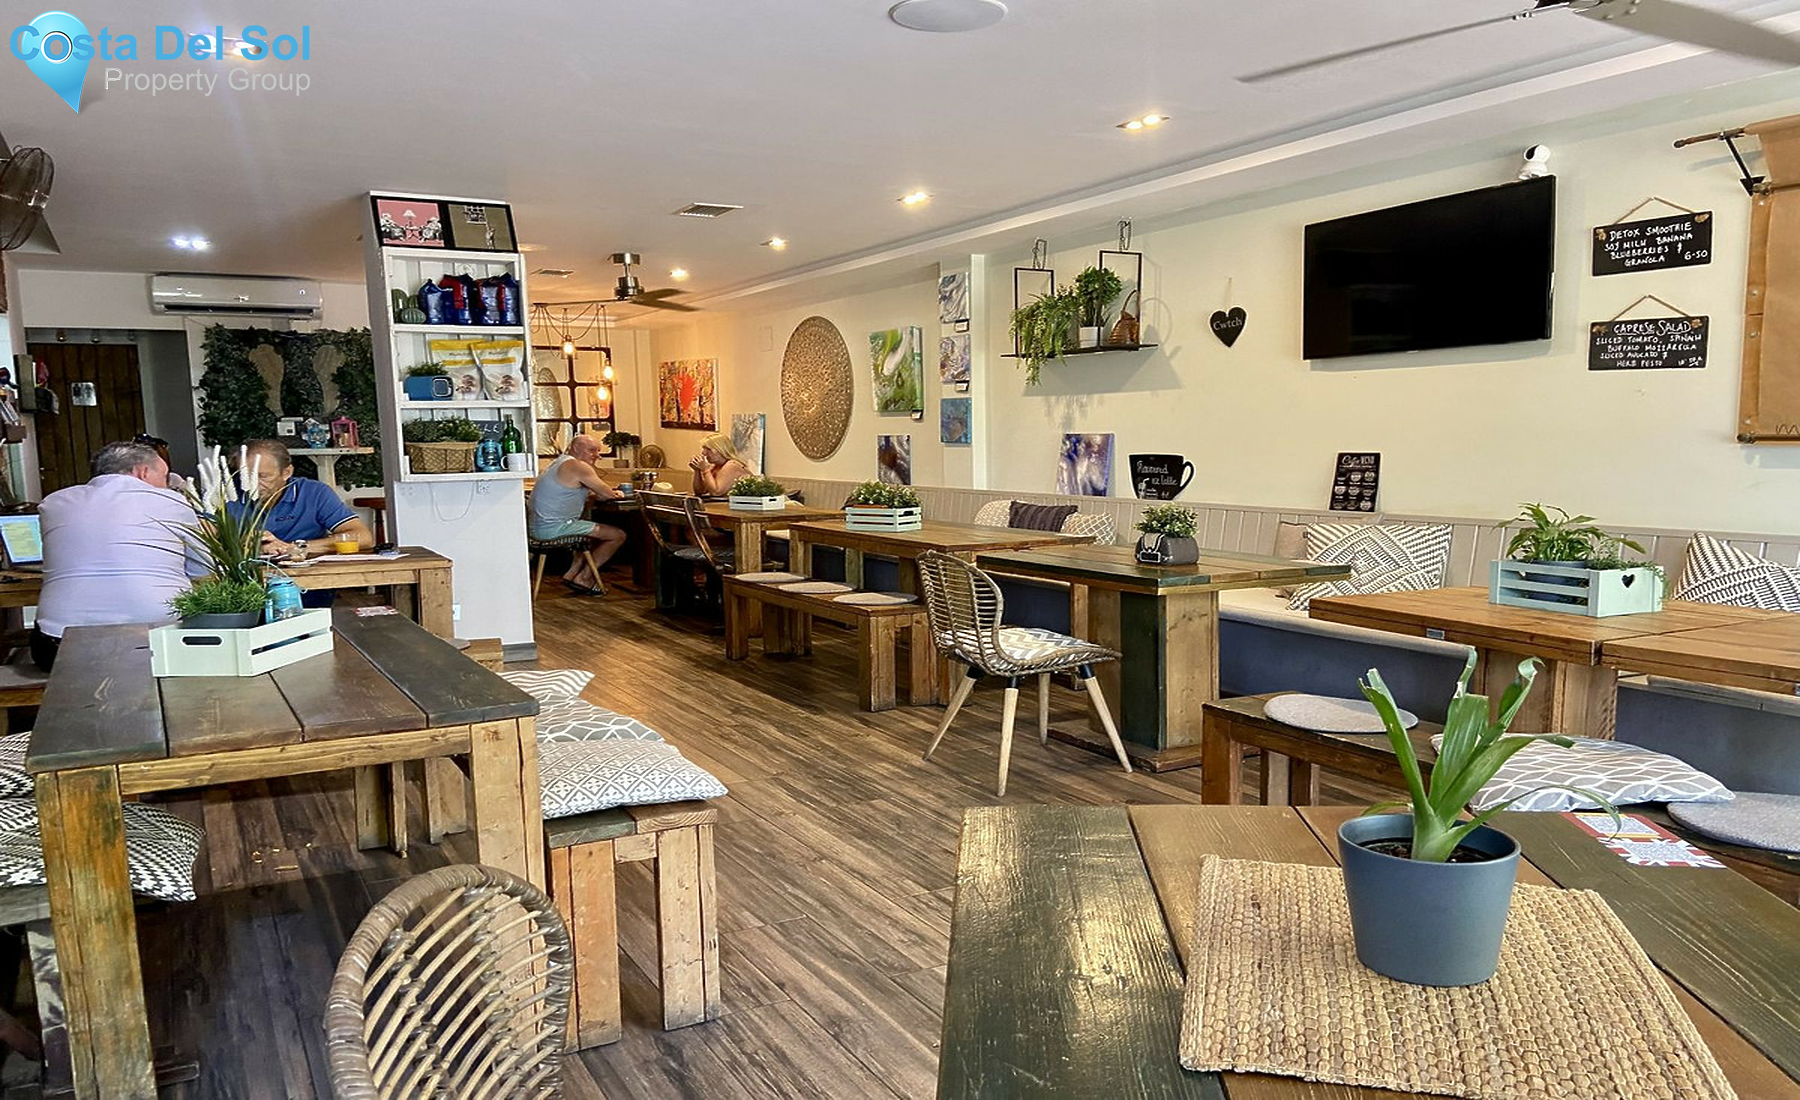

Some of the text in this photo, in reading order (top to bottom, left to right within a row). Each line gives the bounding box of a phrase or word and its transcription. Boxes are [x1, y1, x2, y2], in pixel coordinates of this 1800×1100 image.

[1609, 221, 1693, 241] DETOX SMOOTHIE
[1604, 242, 1620, 252] SOY
[1655, 234, 1693, 245] BANANA
[1610, 245, 1669, 260] BLUEBERRIES
[1624, 255, 1666, 267] GRANOLA
[1613, 320, 1692, 336] CAPRESE SALAD
[1596, 337, 1622, 345] SLICED
[1640, 360, 1663, 368] PESTO
